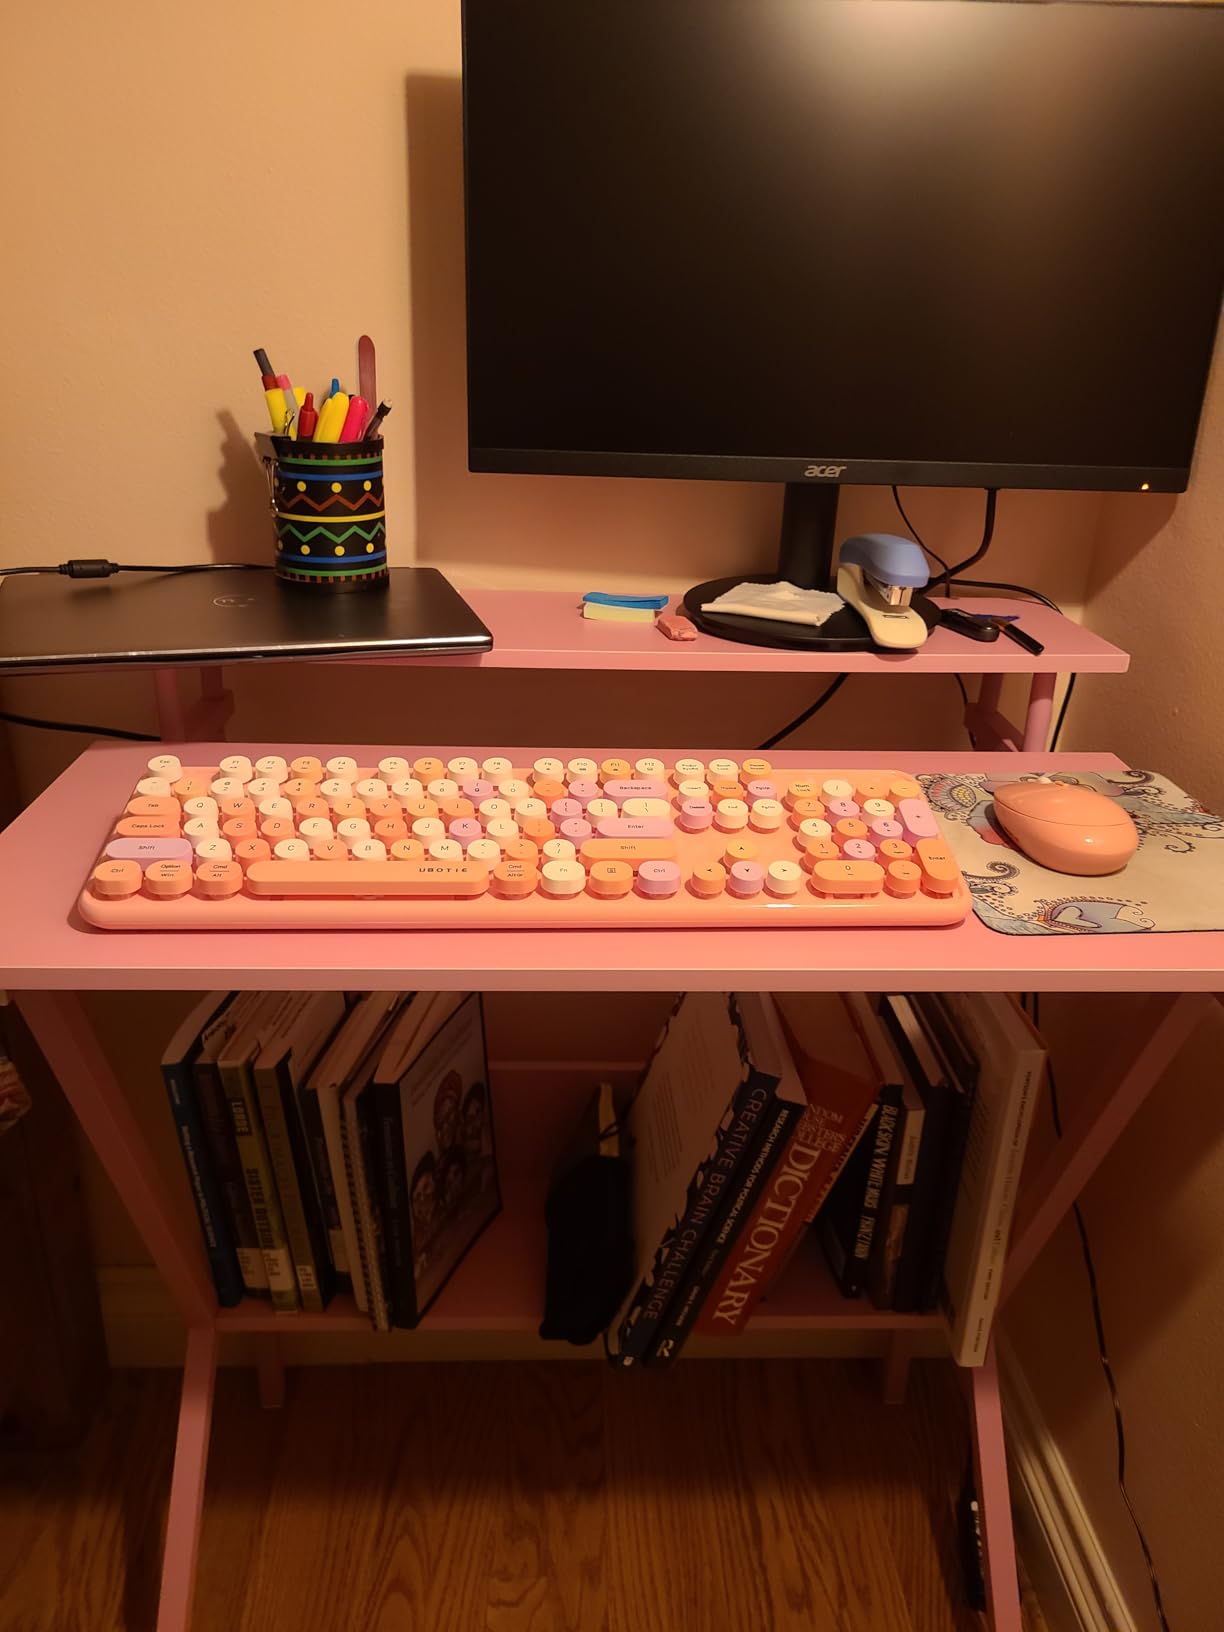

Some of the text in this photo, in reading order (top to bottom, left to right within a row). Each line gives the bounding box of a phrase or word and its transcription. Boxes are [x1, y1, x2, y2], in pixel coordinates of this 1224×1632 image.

[804, 464, 848, 478] acer
[718, 1089, 767, 1168] CREATIVE
[880, 1104, 899, 1130] BLACK
[689, 1172, 726, 1225] BRAIN
[868, 1157, 887, 1187] WHITE
[712, 1143, 820, 1325] DICTIONARY
[644, 1231, 697, 1320] CHALLENGE
